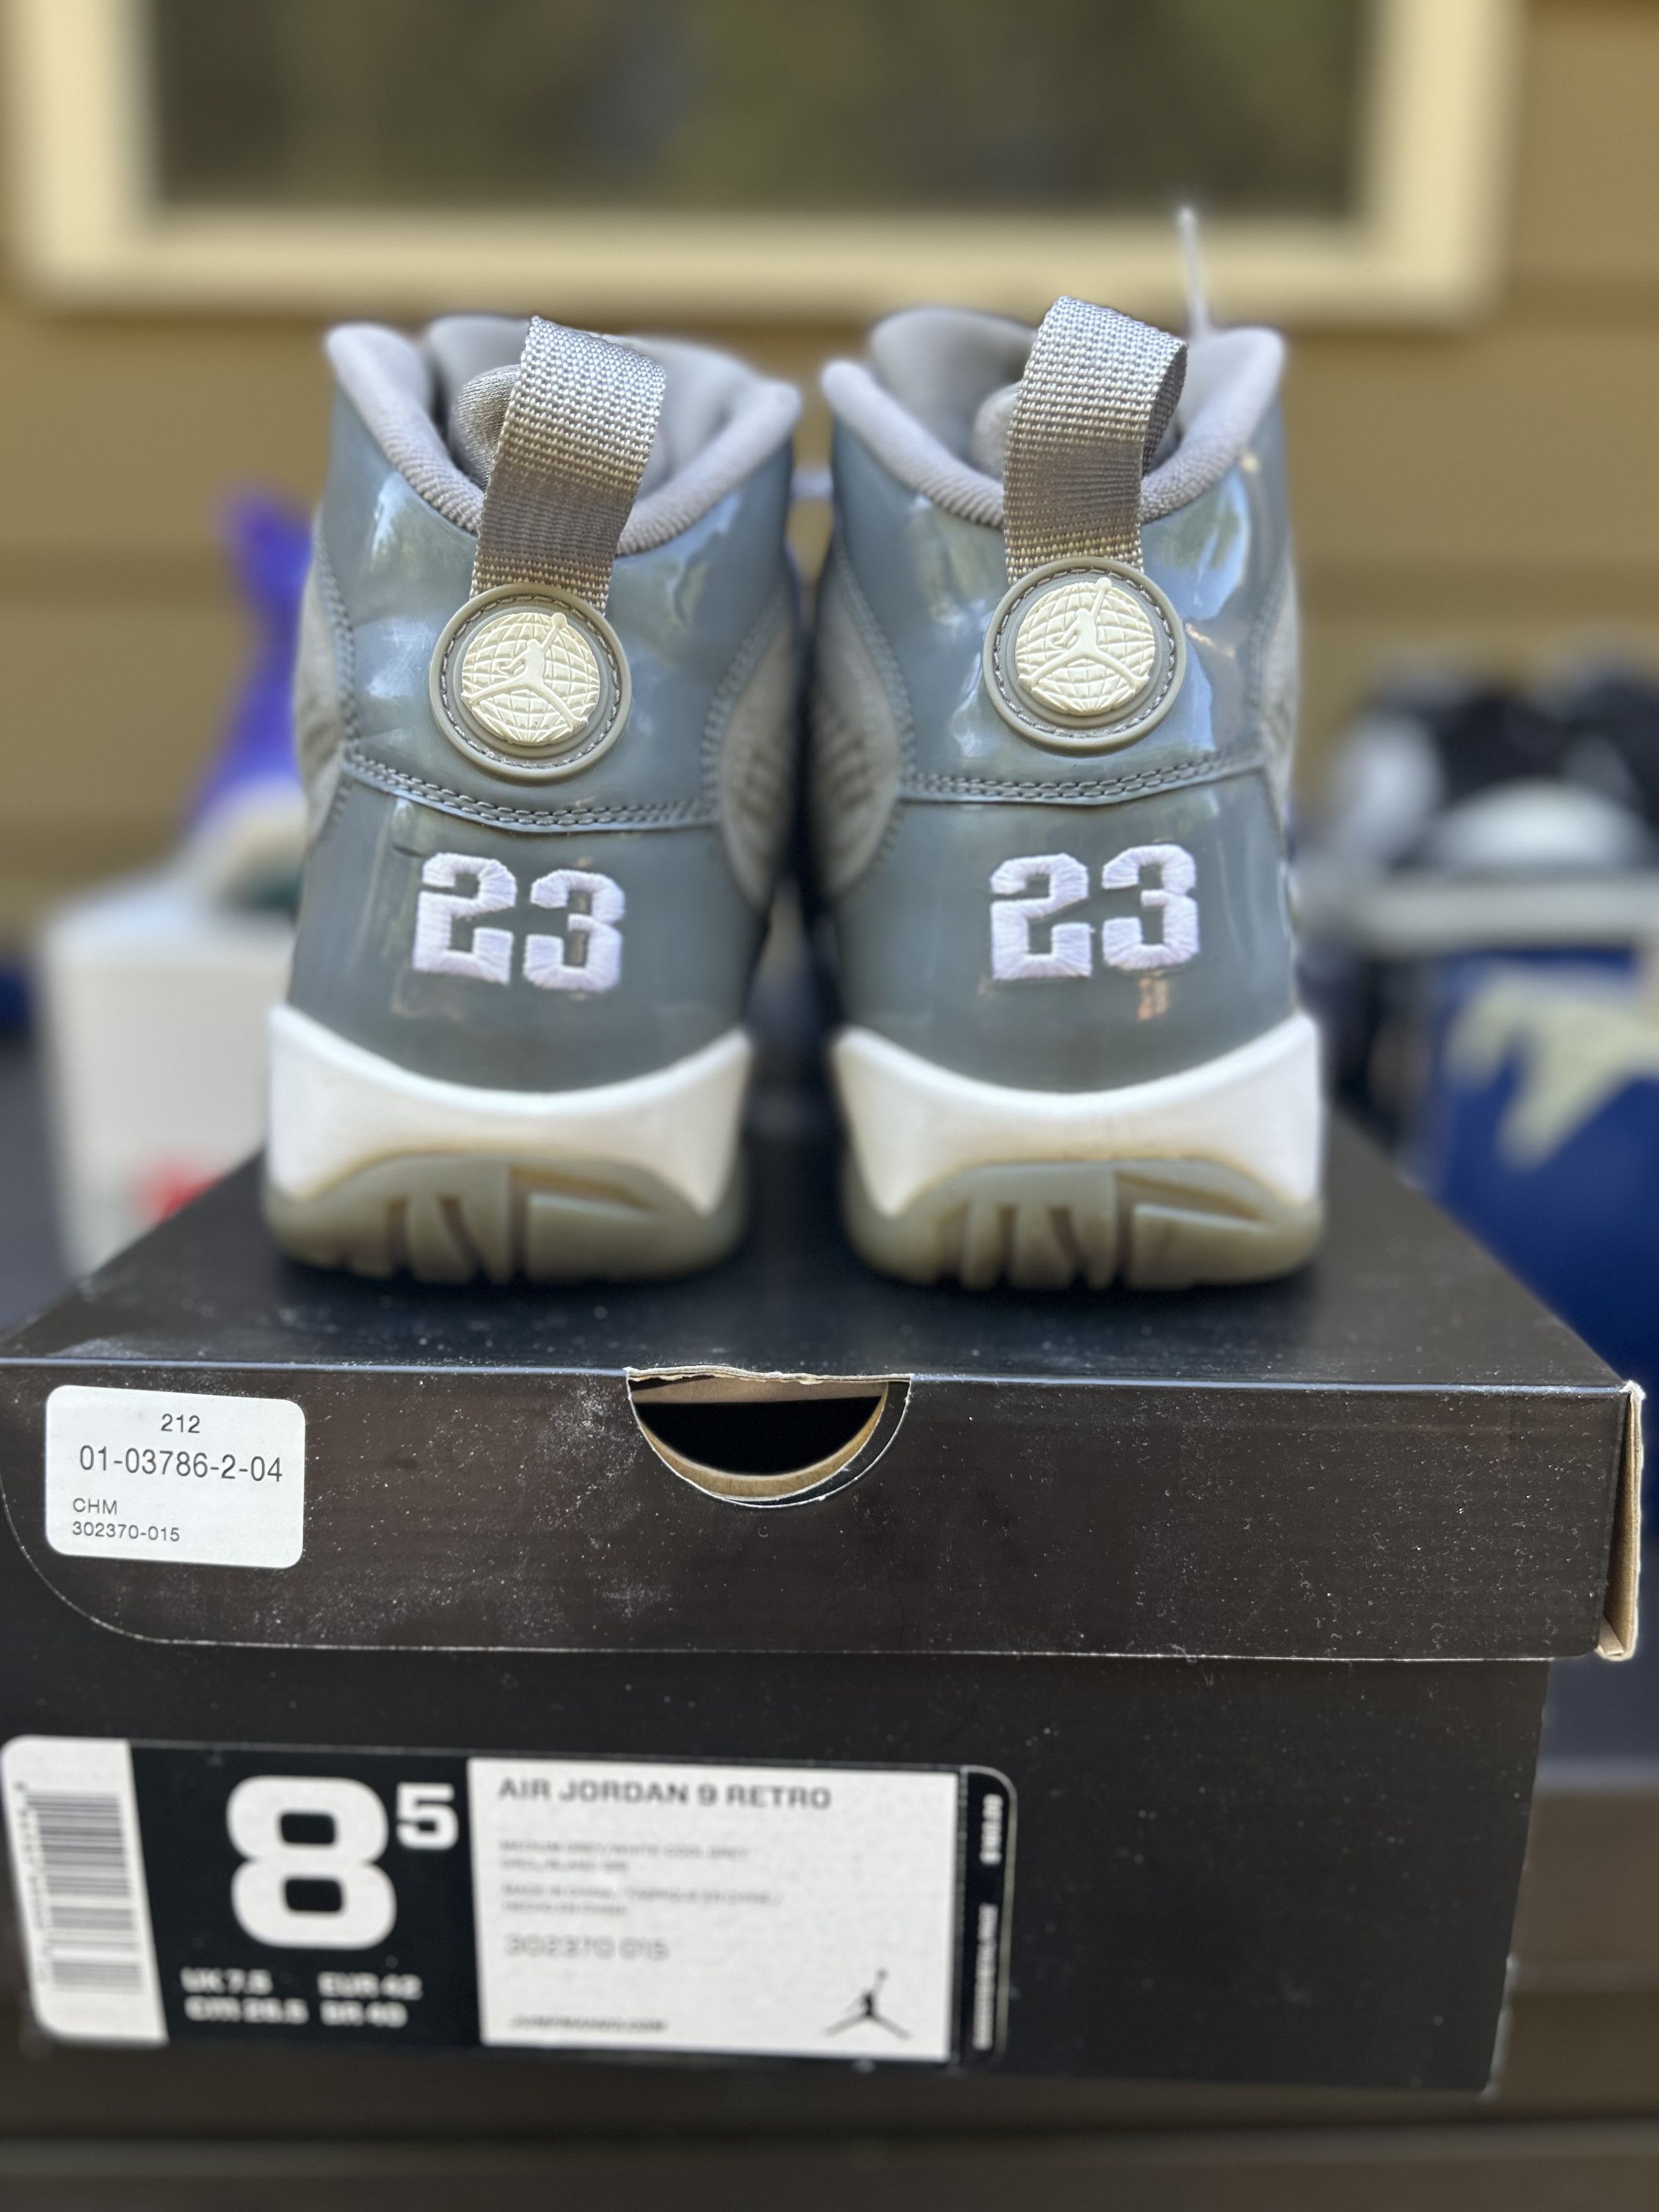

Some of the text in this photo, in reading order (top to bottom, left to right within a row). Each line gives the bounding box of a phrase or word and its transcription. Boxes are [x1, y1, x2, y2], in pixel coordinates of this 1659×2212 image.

[413, 851, 626, 994] 23
[989, 843, 1199, 982] 23
[161, 1414, 201, 1433] 212
[79, 1445, 283, 1483] 01-03786-2-04
[73, 1498, 118, 1515] CHM
[72, 1521, 180, 1541] 302370-015
[499, 1777, 832, 1809] AIR JORDAN 9 RETRO
[227, 1775, 458, 1949] 8 5
